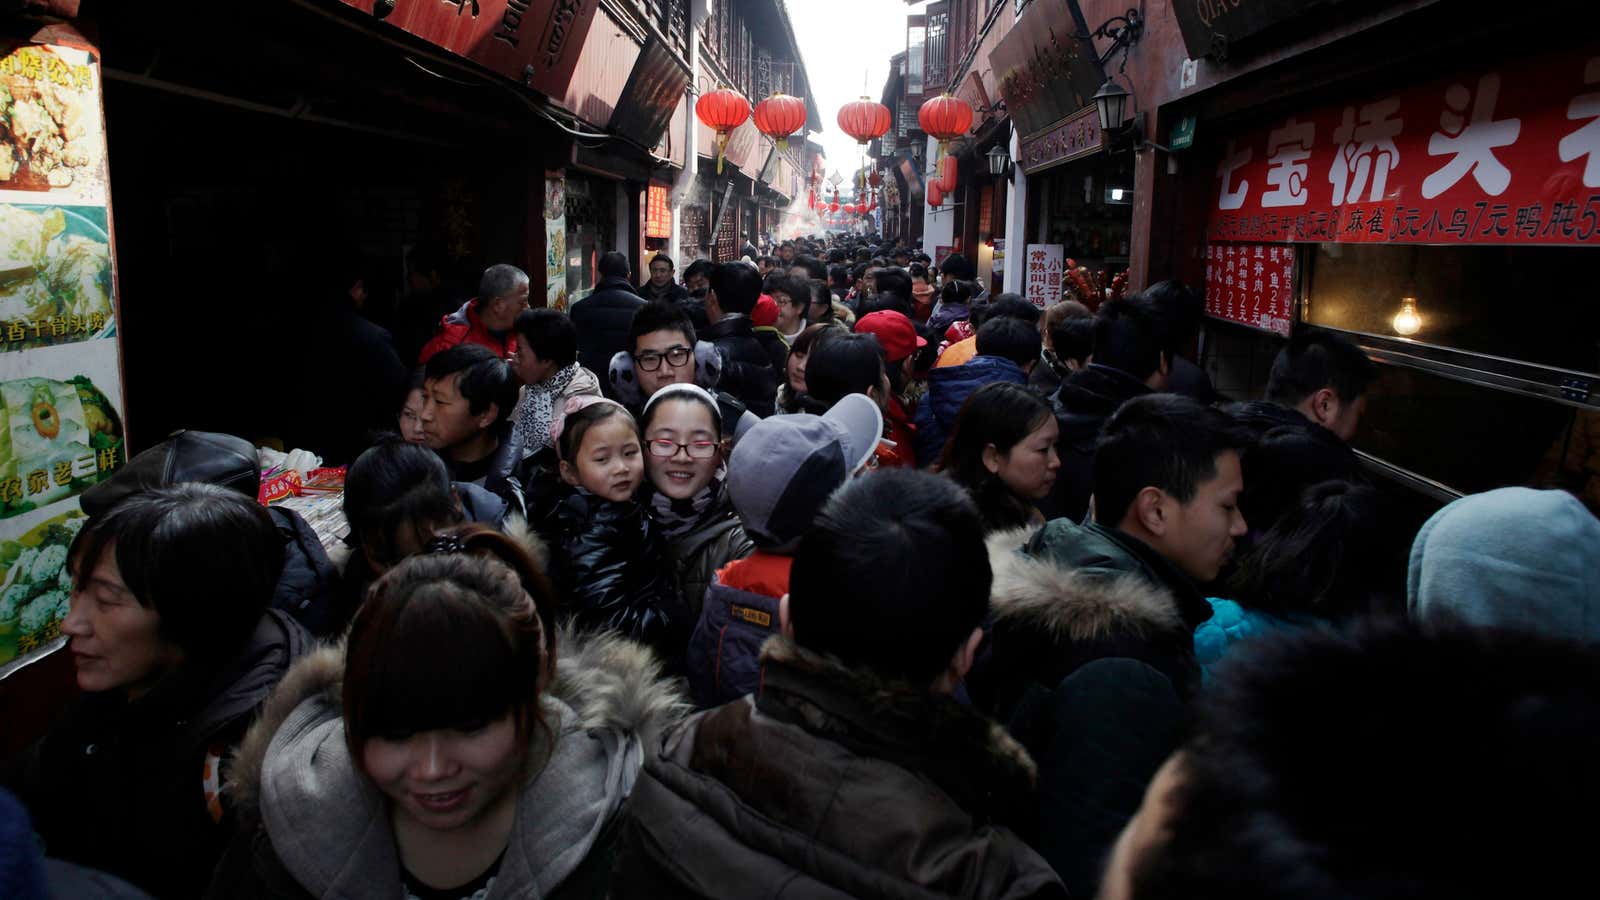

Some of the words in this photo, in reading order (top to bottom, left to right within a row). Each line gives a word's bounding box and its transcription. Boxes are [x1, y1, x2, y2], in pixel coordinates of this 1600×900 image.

[1029, 250, 1046, 307] 常熟叫化鸡
